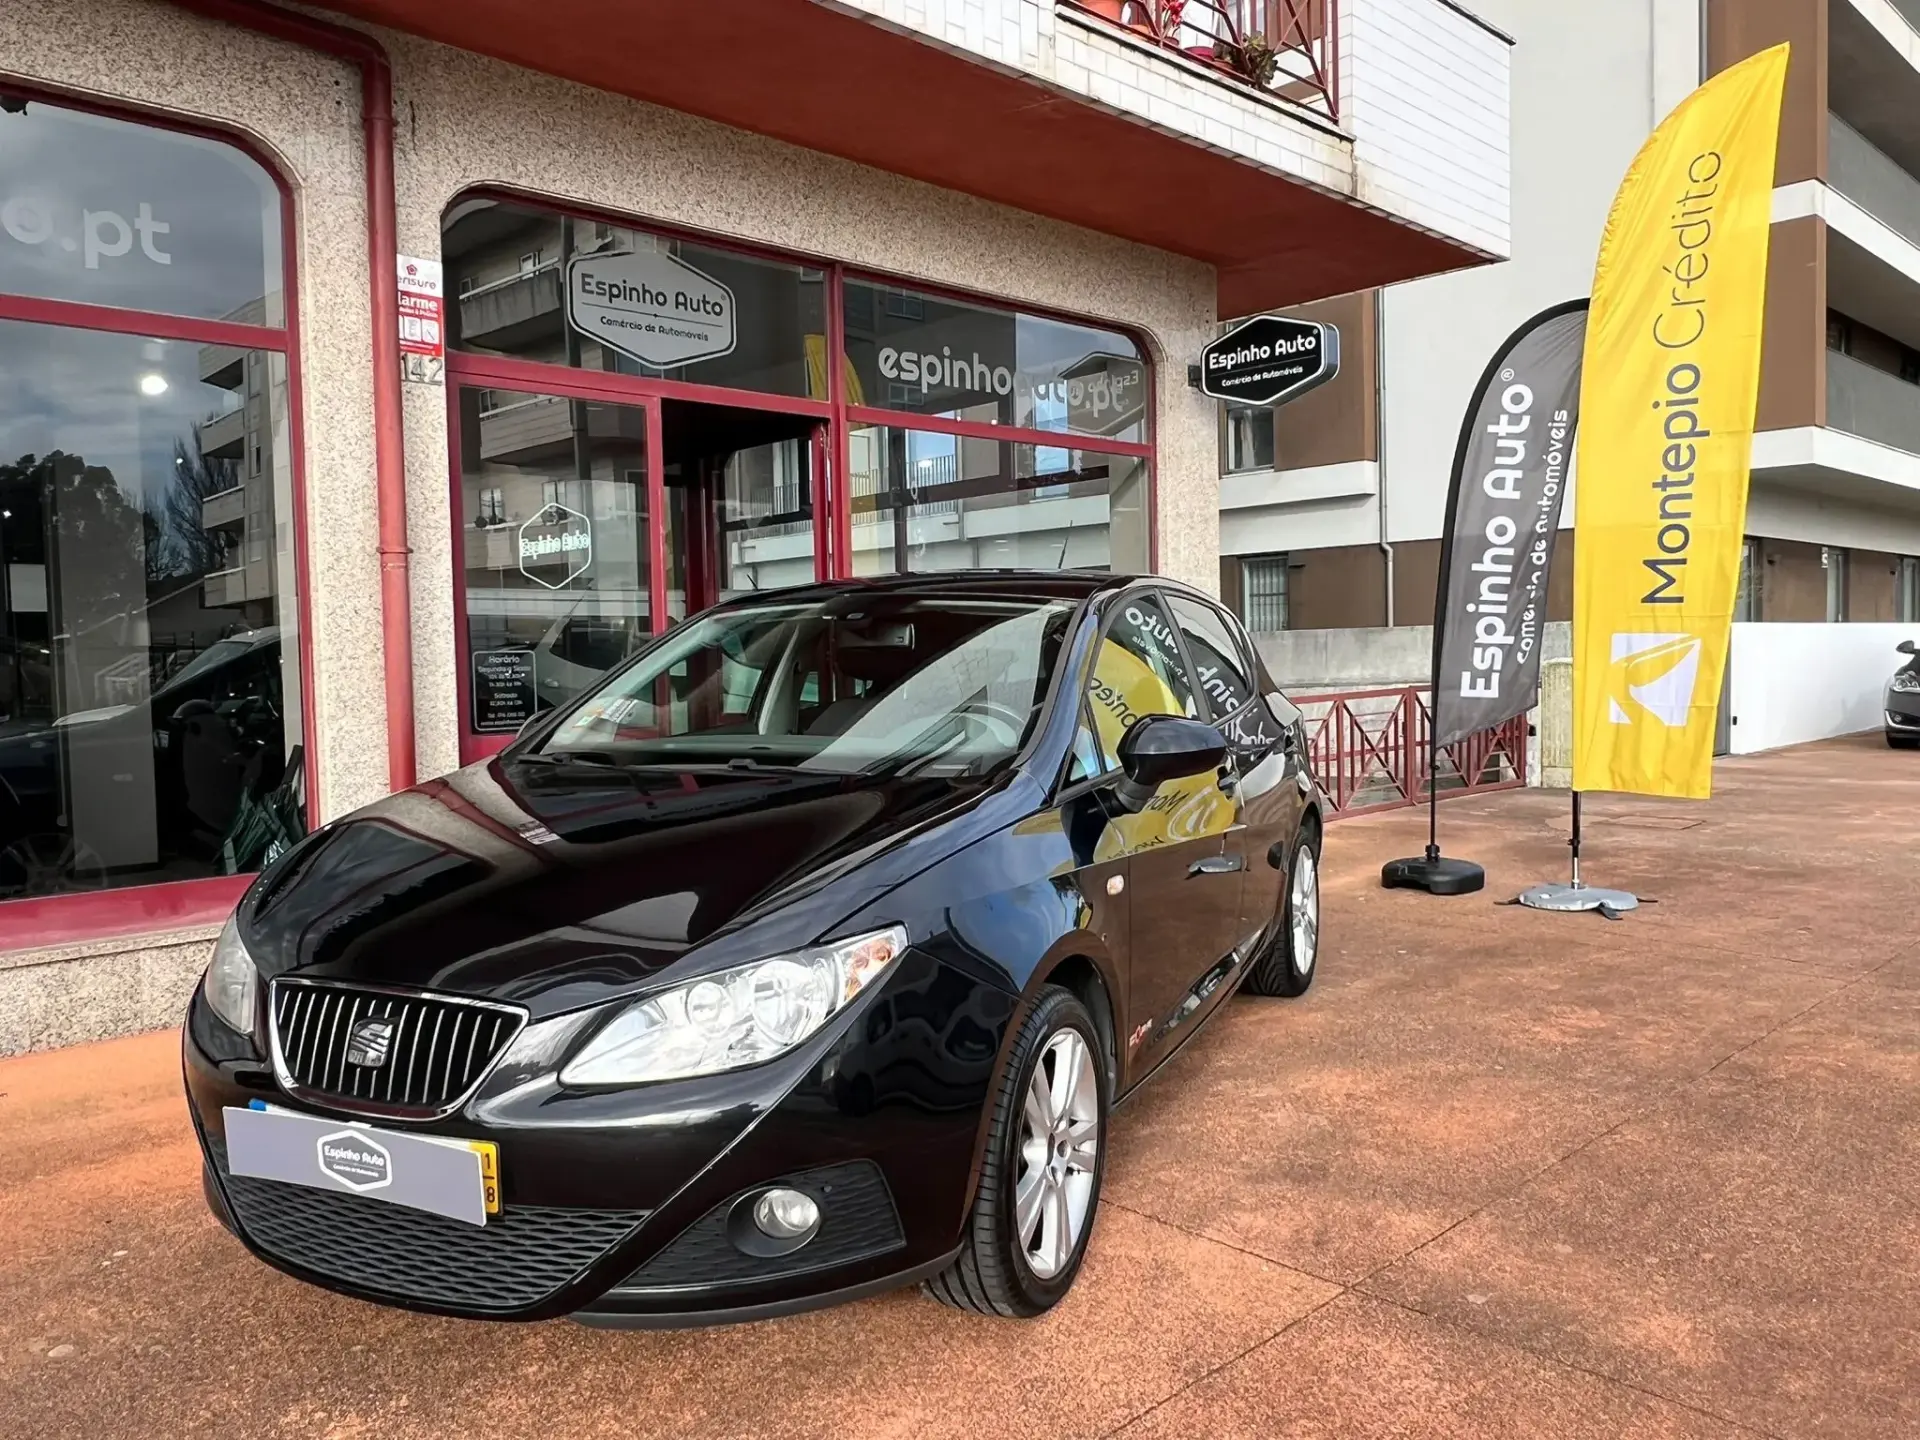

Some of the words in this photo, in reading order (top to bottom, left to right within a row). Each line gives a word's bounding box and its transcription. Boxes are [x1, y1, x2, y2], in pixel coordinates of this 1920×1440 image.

[1652, 151, 1722, 349] Crédito
[397, 291, 438, 311] larme
[581, 272, 668, 307] Espinho
[675, 291, 724, 317] Auto
[600, 316, 643, 331] Comércio
[645, 324, 656, 333] de
[658, 325, 709, 342] Automóveis
[402, 353, 442, 382] 142
[1209, 343, 1271, 370] Espinho
[1275, 334, 1317, 356] Auto
[1483, 383, 1534, 500] Auto
[1641, 363, 1711, 604] Montepio
[1530, 539, 1547, 565] de
[1460, 515, 1517, 698] Espinho
[324, 1145, 361, 1161] Espinho
[362, 1152, 385, 1167] Auto
